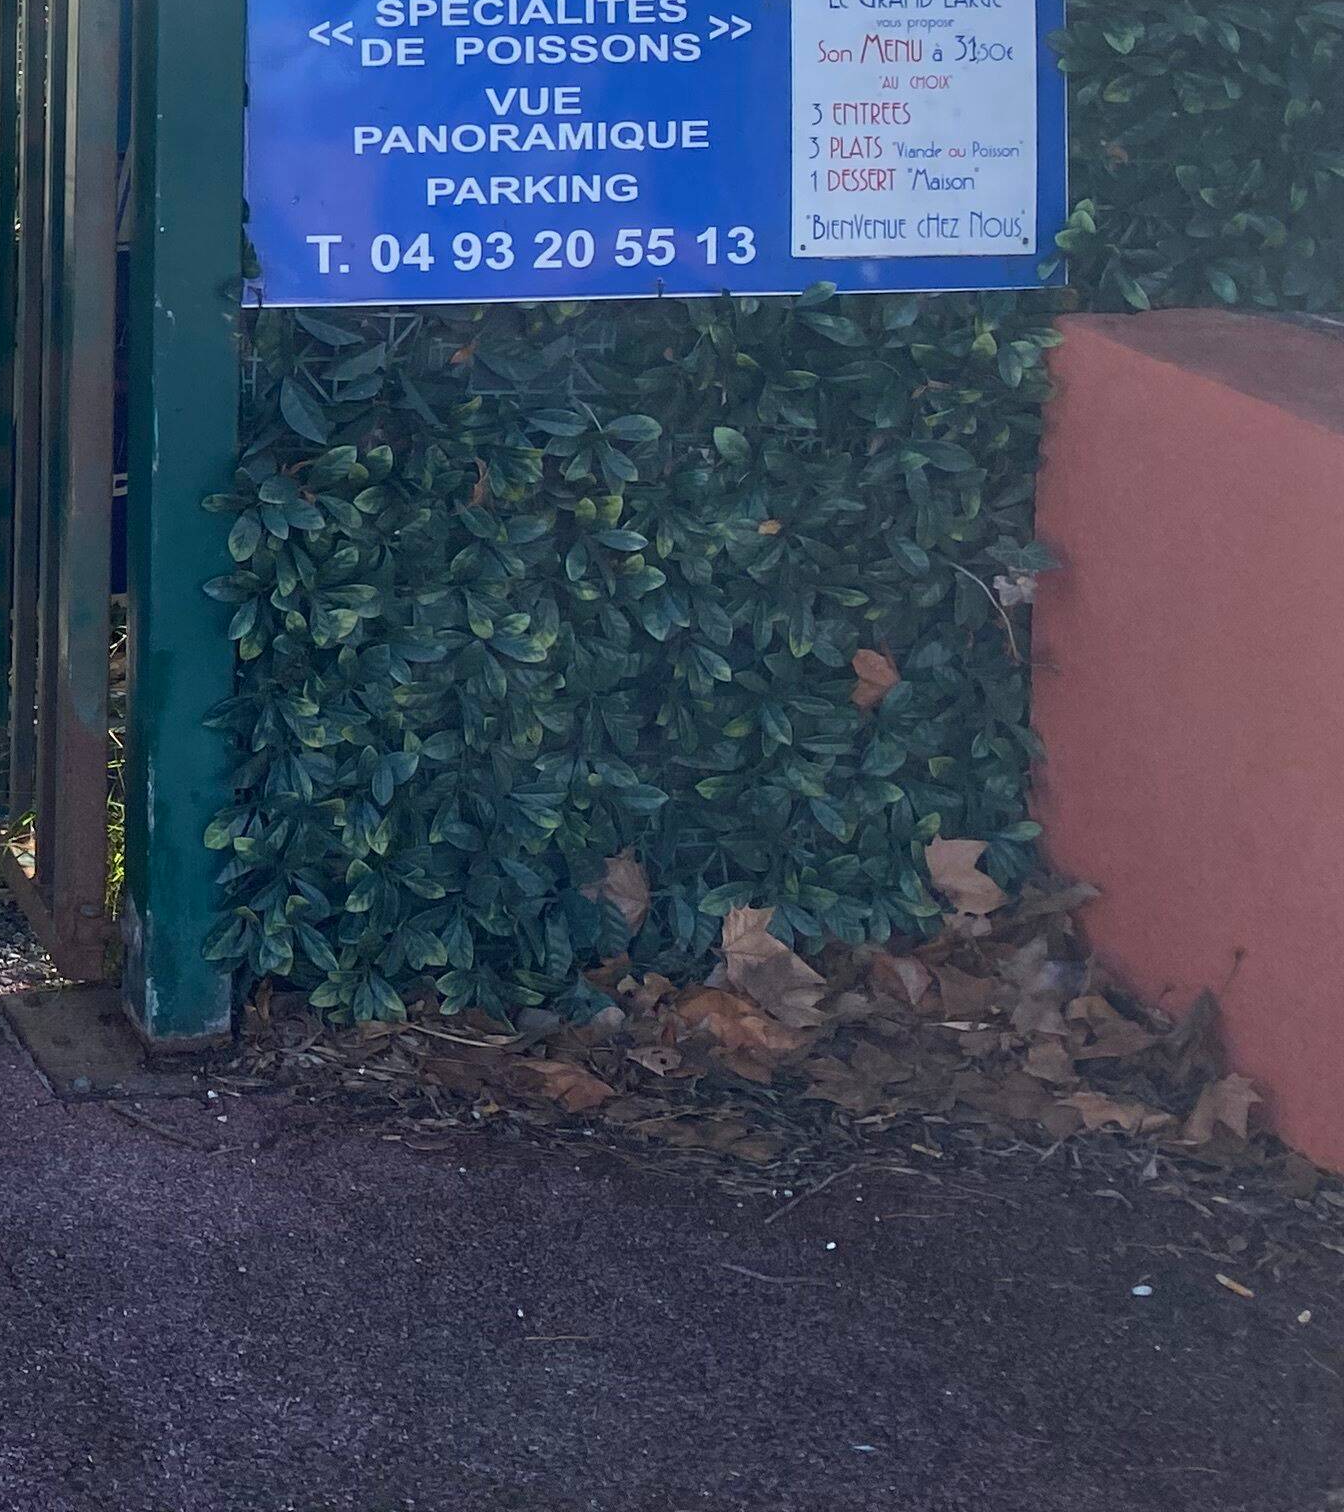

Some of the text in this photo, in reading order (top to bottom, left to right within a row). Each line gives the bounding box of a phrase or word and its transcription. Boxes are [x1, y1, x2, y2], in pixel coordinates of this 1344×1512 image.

[876, 18, 955, 33] vous propose
[360, 37, 425, 67] DE
[455, 33, 702, 65] POISSONS
[817, 39, 853, 64] Son
[860, 34, 923, 64] MENU
[932, 43, 943, 62] à
[485, 86, 582, 116] VUE
[811, 102, 911, 126] 3 ENTREES
[353, 120, 710, 155] PANORAMIQUE
[809, 136, 820, 159] 3
[830, 136, 883, 159] PLATS
[948, 147, 966, 158] ou
[426, 173, 640, 206] PARKING
[810, 170, 818, 192] 1
[827, 169, 896, 191] DESSERT
[306, 226, 757, 274] T. 04 93 20 55 13
